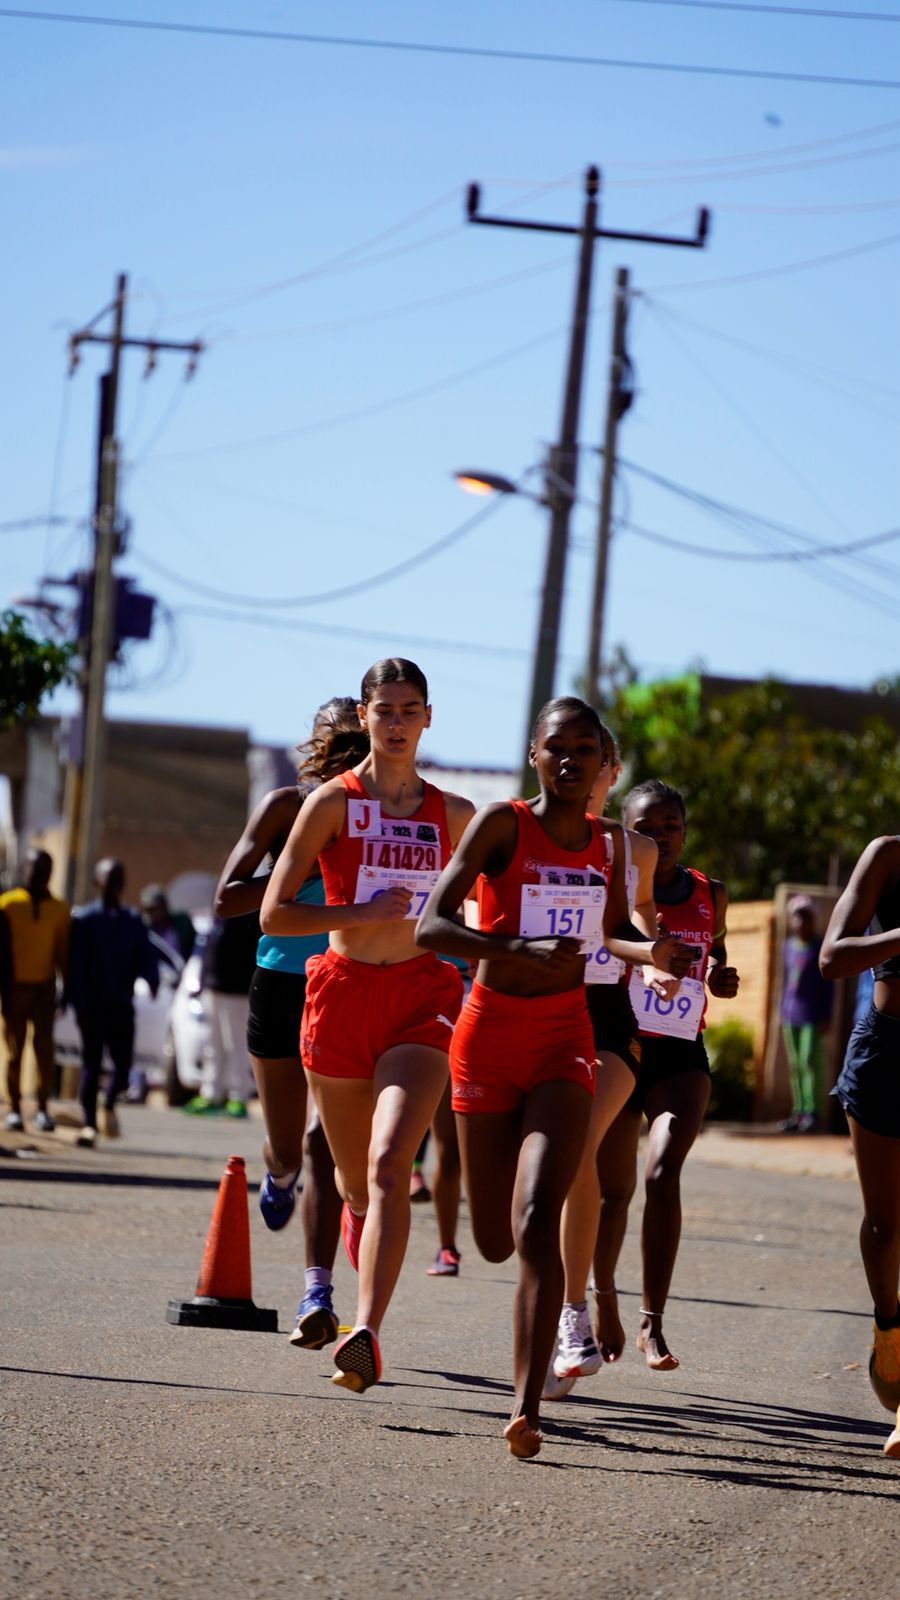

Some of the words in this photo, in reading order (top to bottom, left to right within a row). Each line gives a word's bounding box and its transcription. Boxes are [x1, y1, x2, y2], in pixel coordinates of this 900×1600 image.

[355, 805, 370, 830] J
[547, 908, 584, 935] 151
[643, 989, 692, 1019] 109
